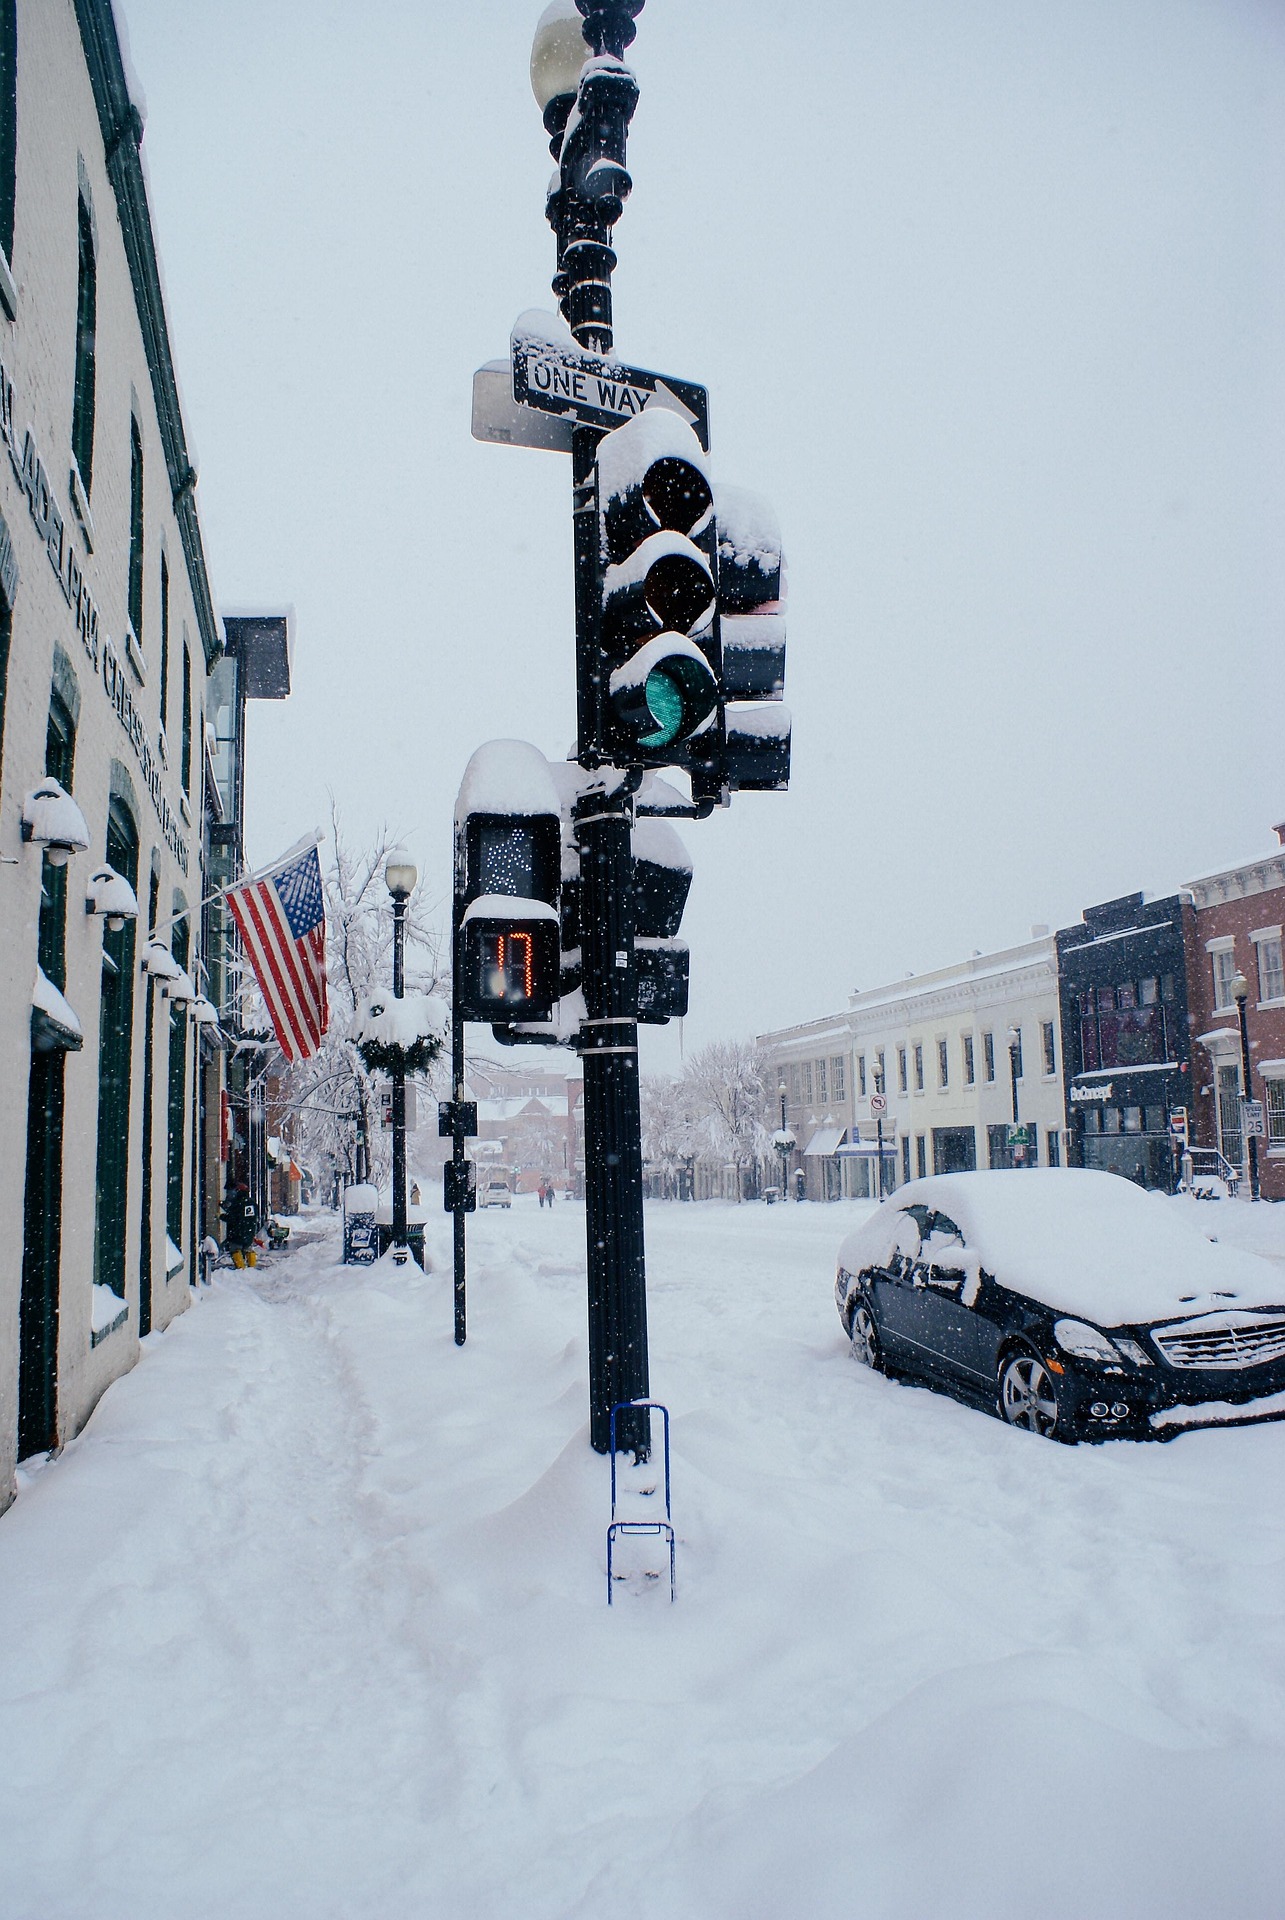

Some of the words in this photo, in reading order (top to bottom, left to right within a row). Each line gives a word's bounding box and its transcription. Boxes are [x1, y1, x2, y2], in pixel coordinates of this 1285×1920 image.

[535, 363, 588, 402] ONE
[597, 380, 651, 415] WAY
[498, 932, 532, 998] 17
[1248, 1120, 1263, 1133] 25
